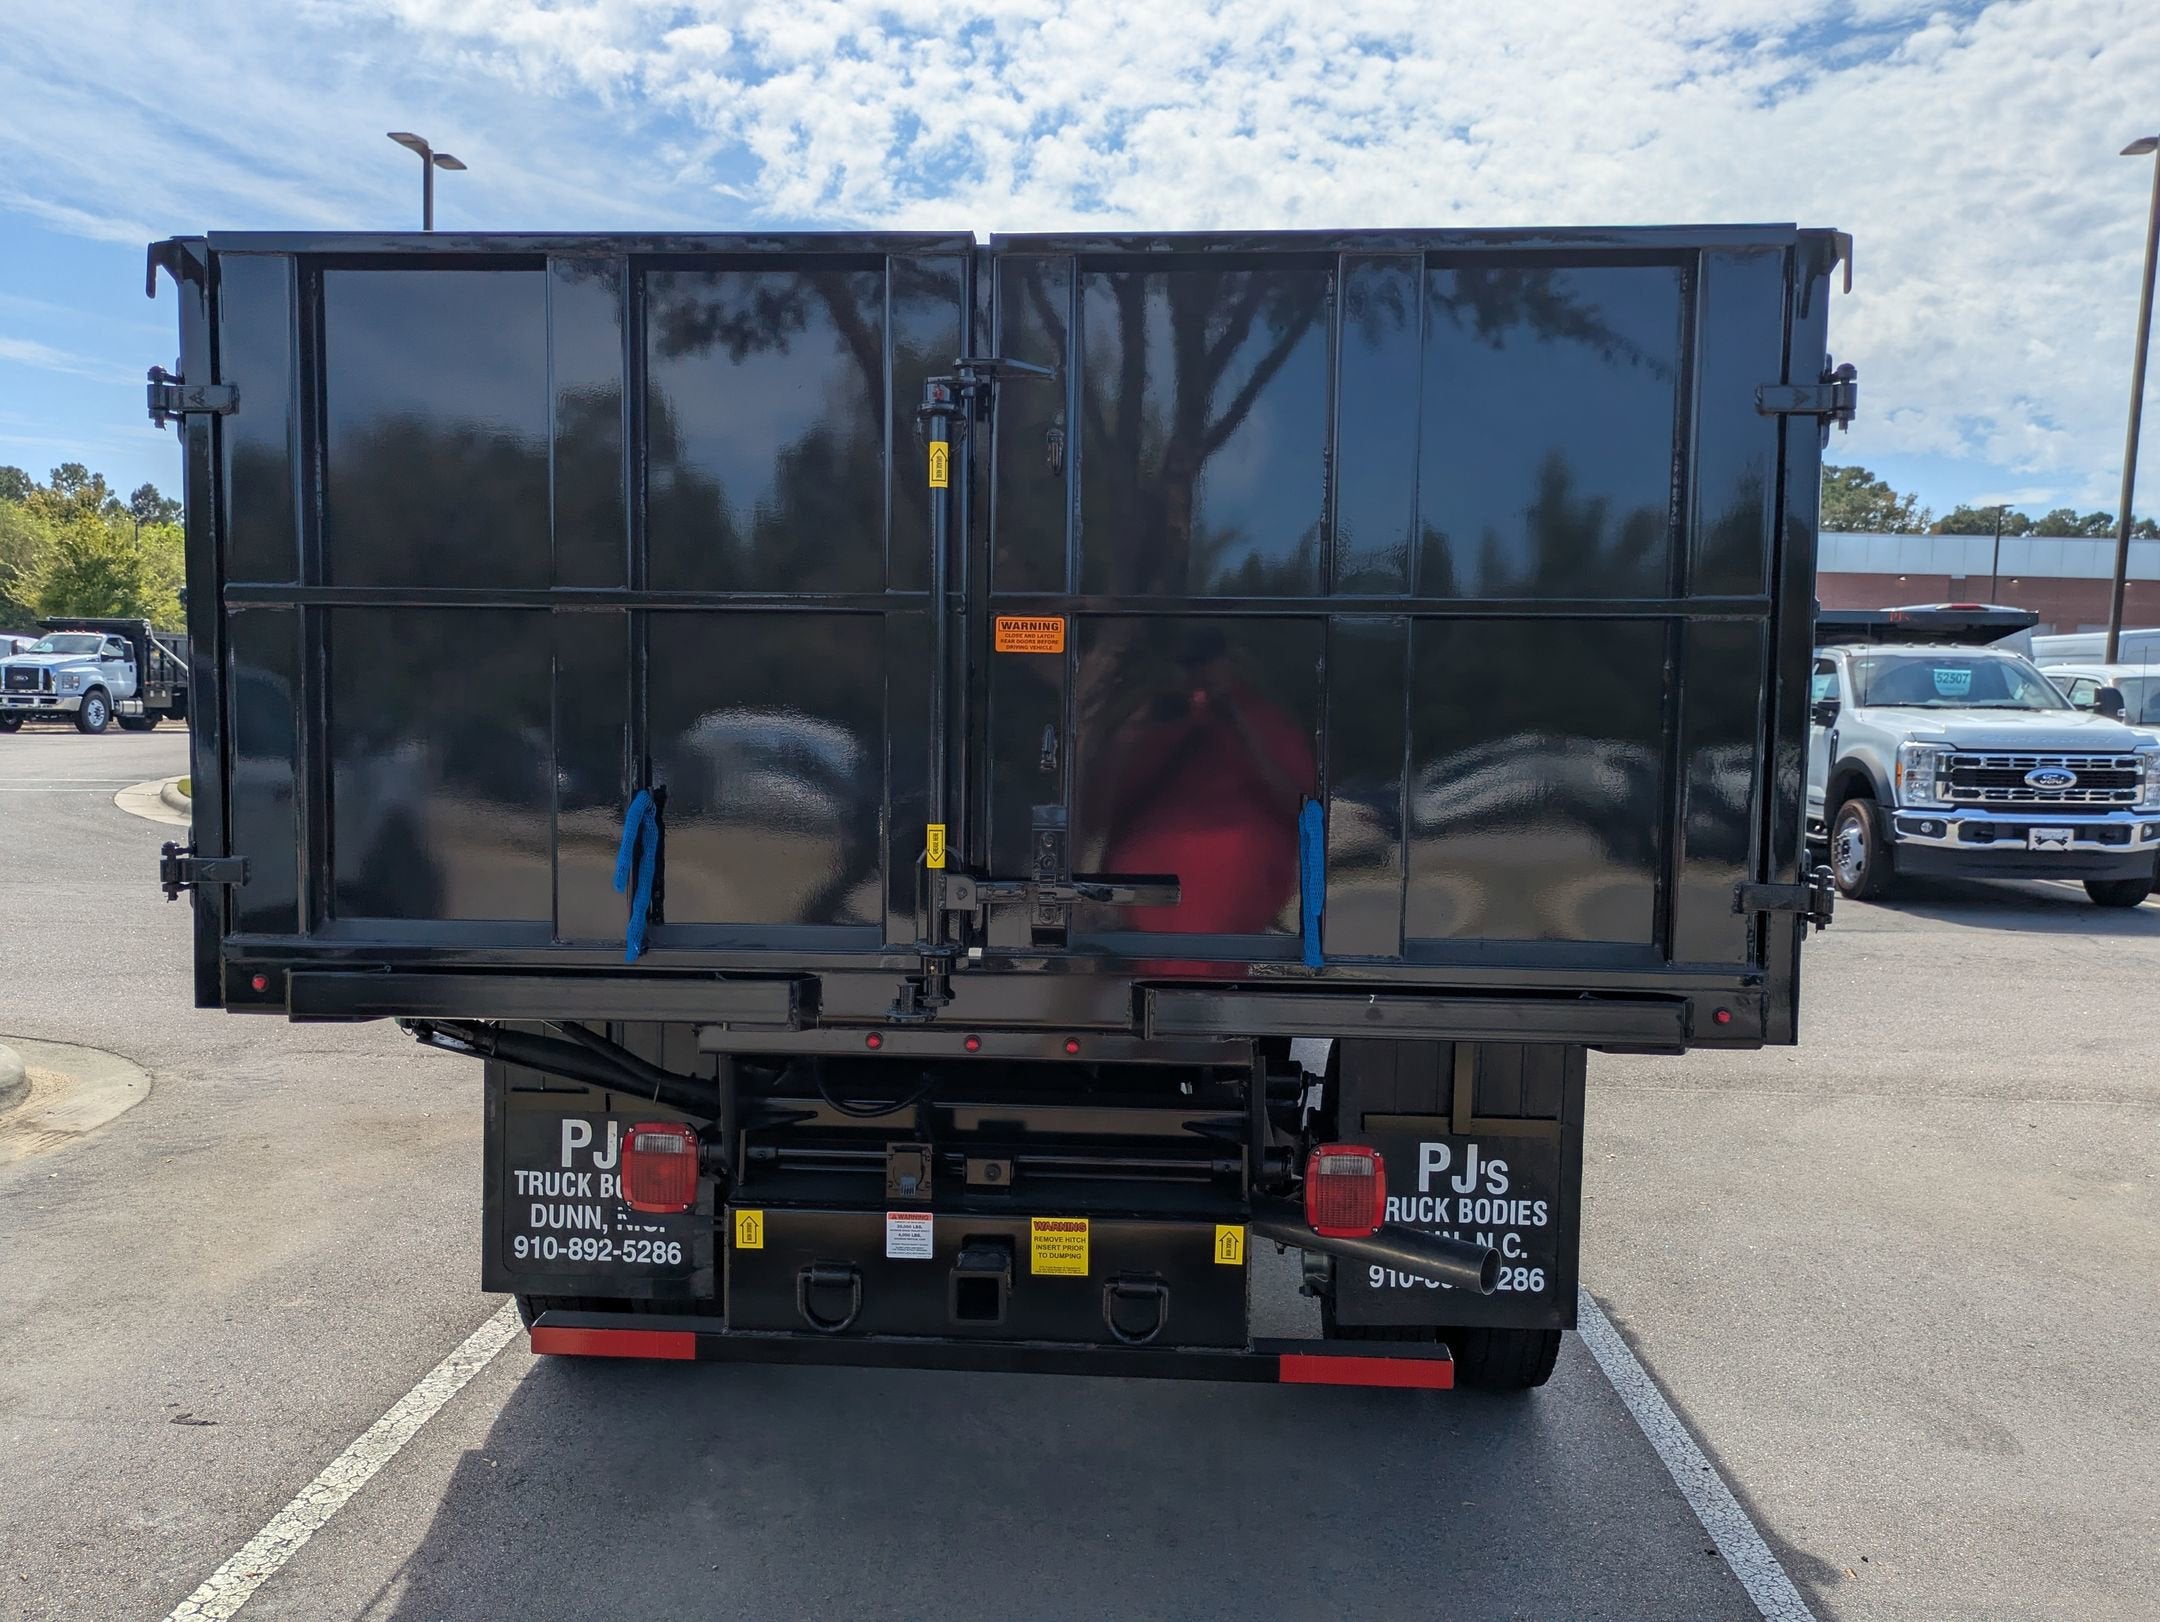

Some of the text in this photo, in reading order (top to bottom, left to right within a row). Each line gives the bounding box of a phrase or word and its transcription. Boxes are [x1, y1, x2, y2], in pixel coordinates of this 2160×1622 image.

[1000, 621, 1059, 631] WARNING
[1936, 672, 1970, 685] 52507
[561, 1119, 624, 1169] PJ
[514, 1170, 592, 1198] TRUCK
[530, 1203, 609, 1235] DUNN,
[1384, 1196, 1548, 1226] RUCK BODIES
[1033, 1221, 1087, 1232] WARNING
[513, 1235, 682, 1265] 910-892-5286
[1475, 1231, 1528, 1259] NC.
